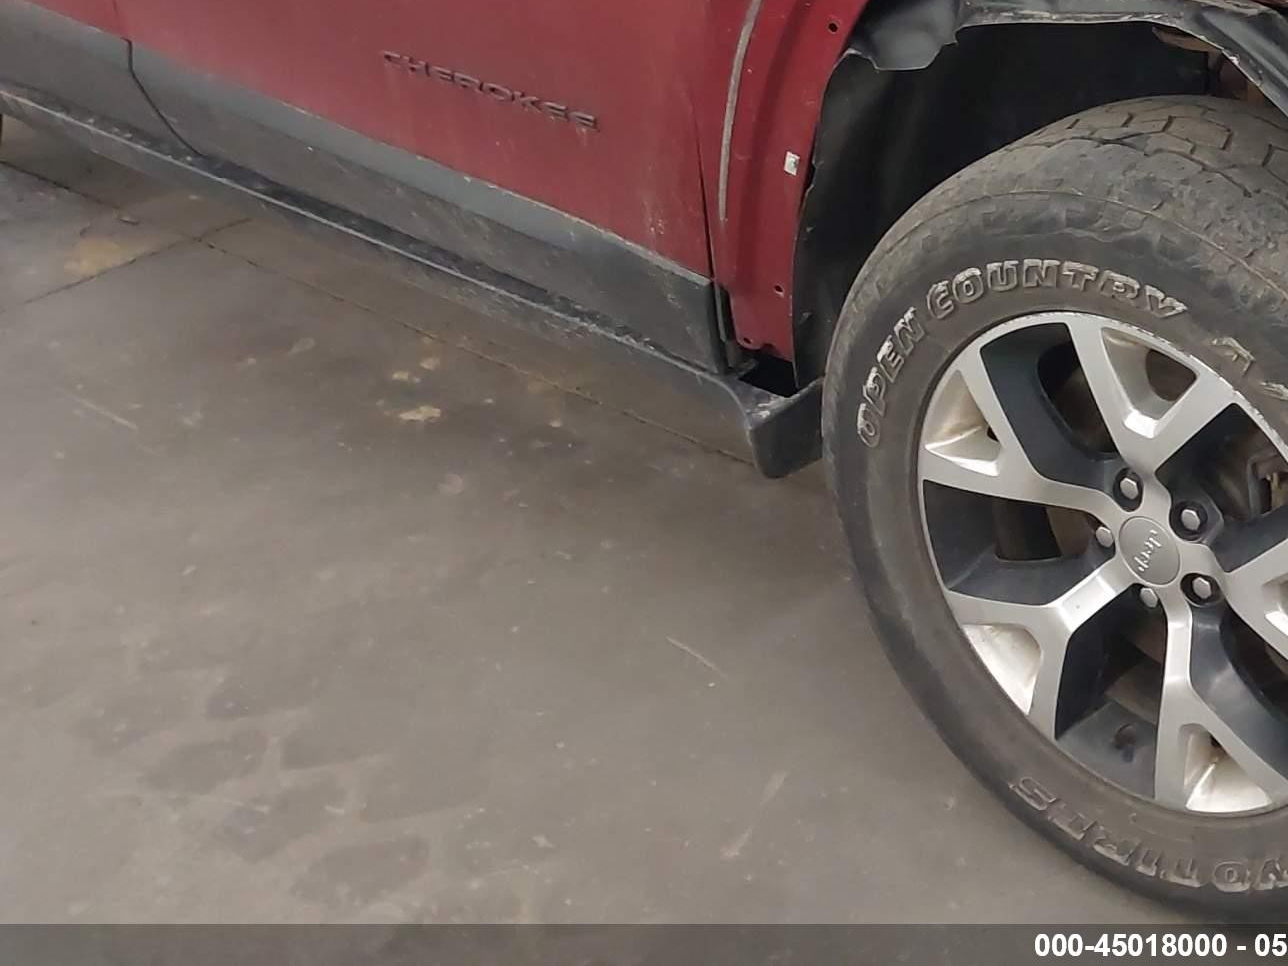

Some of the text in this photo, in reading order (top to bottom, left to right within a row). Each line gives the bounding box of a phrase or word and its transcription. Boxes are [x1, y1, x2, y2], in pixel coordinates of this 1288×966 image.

[383, 49, 599, 132] CHEROKEE
[857, 258, 1189, 448] OPEN COUNTRY
[1007, 777, 1202, 888] TIRES
